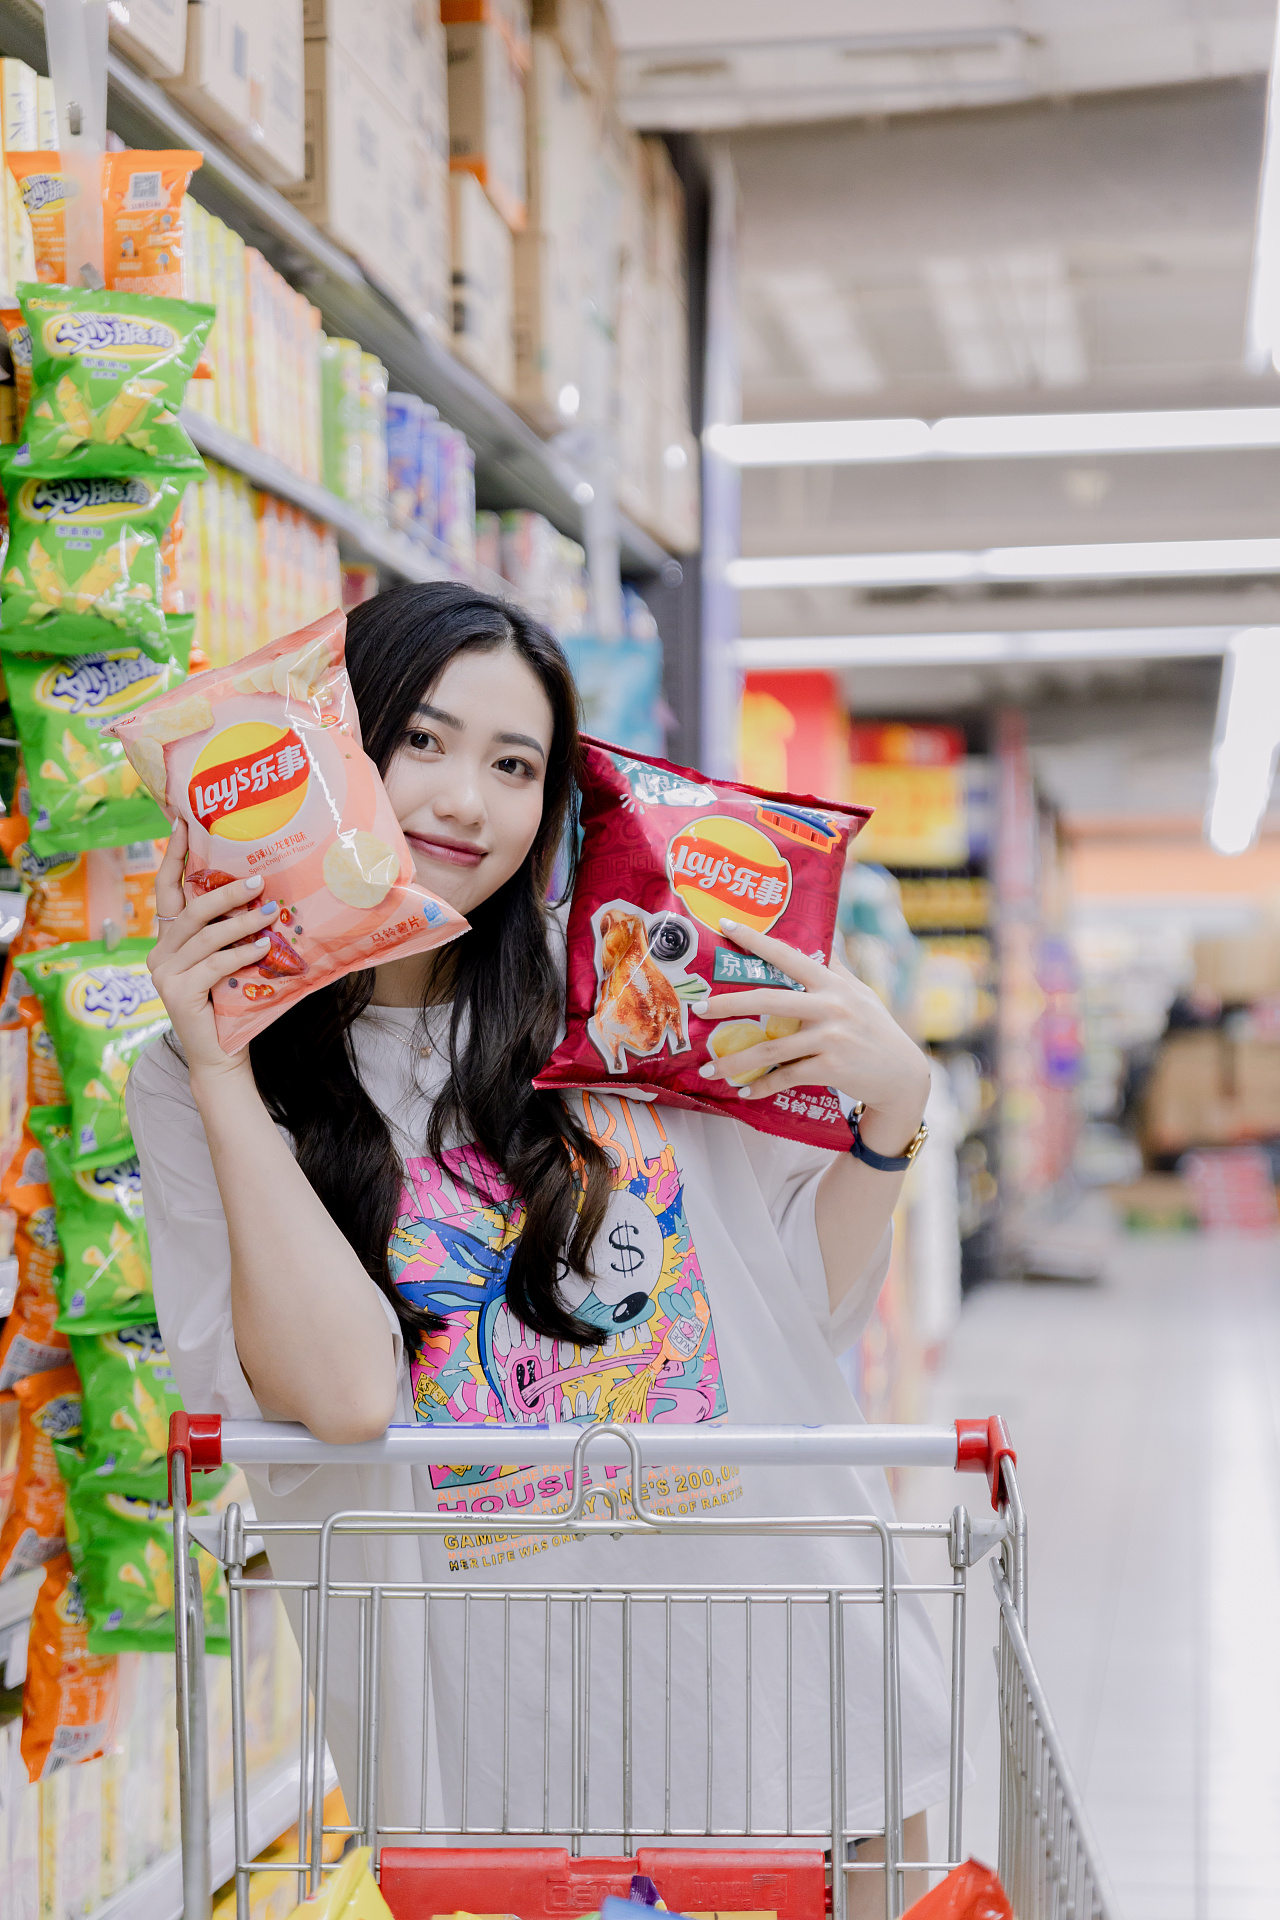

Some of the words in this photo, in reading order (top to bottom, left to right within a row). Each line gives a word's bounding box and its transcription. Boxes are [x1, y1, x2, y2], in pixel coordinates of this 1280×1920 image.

[195, 767, 251, 819] Lay's
[251, 744, 307, 792] 乐事
[246, 831, 307, 865] 香辣小龙虾味
[249, 863, 266, 875] Spicy
[265, 850, 292, 866] Crayfish
[292, 841, 316, 854] Flavor
[674, 845, 735, 889] Lay's
[727, 867, 787, 906] 乐事
[370, 916, 419, 944] 马铃薯片
[773, 1094, 841, 1124] 马铃薯片
[820, 1095, 840, 1110] 135
[671, 1330, 693, 1353] NUDE
[437, 1465, 592, 1513] HOUSE
[437, 1488, 466, 1503] ALL
[468, 1484, 490, 1498] MY
[449, 1558, 479, 1571] HER
[482, 1551, 515, 1568] LIFE
[519, 1541, 548, 1559] WAS
[678, 1502, 697, 1514] OF
